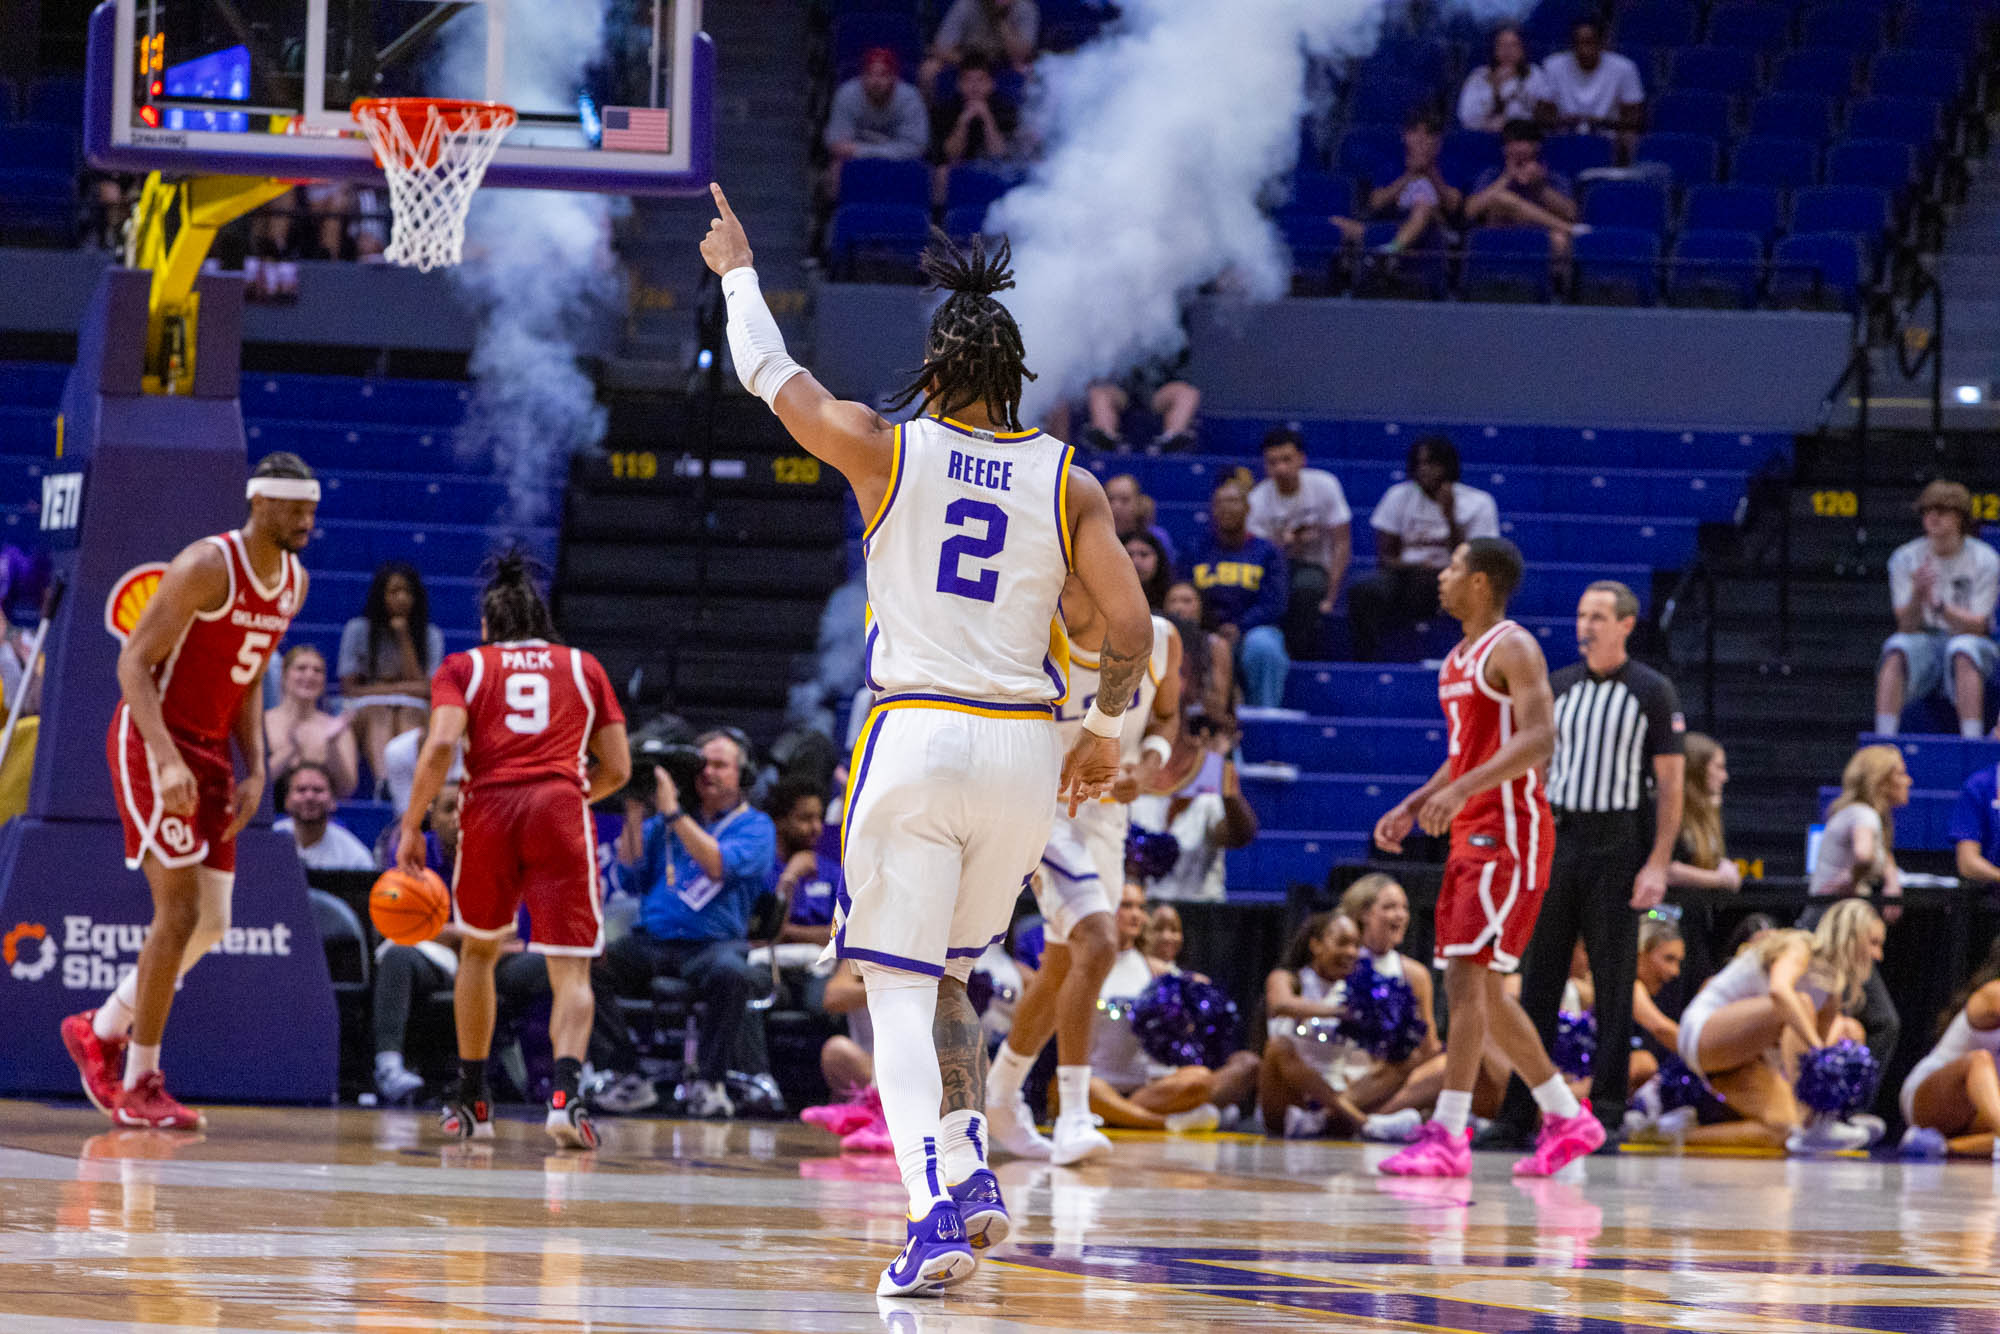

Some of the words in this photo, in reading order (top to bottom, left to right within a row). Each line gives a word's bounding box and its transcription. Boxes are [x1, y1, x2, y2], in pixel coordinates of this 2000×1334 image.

[774, 456, 819, 484] 120
[948, 450, 1013, 491] REECE
[41, 472, 83, 530] YETI
[1812, 490, 1858, 516] 120
[1971, 493, 2000, 520] 12
[936, 497, 1009, 603] 2
[230, 630, 272, 685] 5
[501, 650, 554, 671] PACK
[504, 672, 550, 734] 9
[63, 915, 291, 958] Equent
